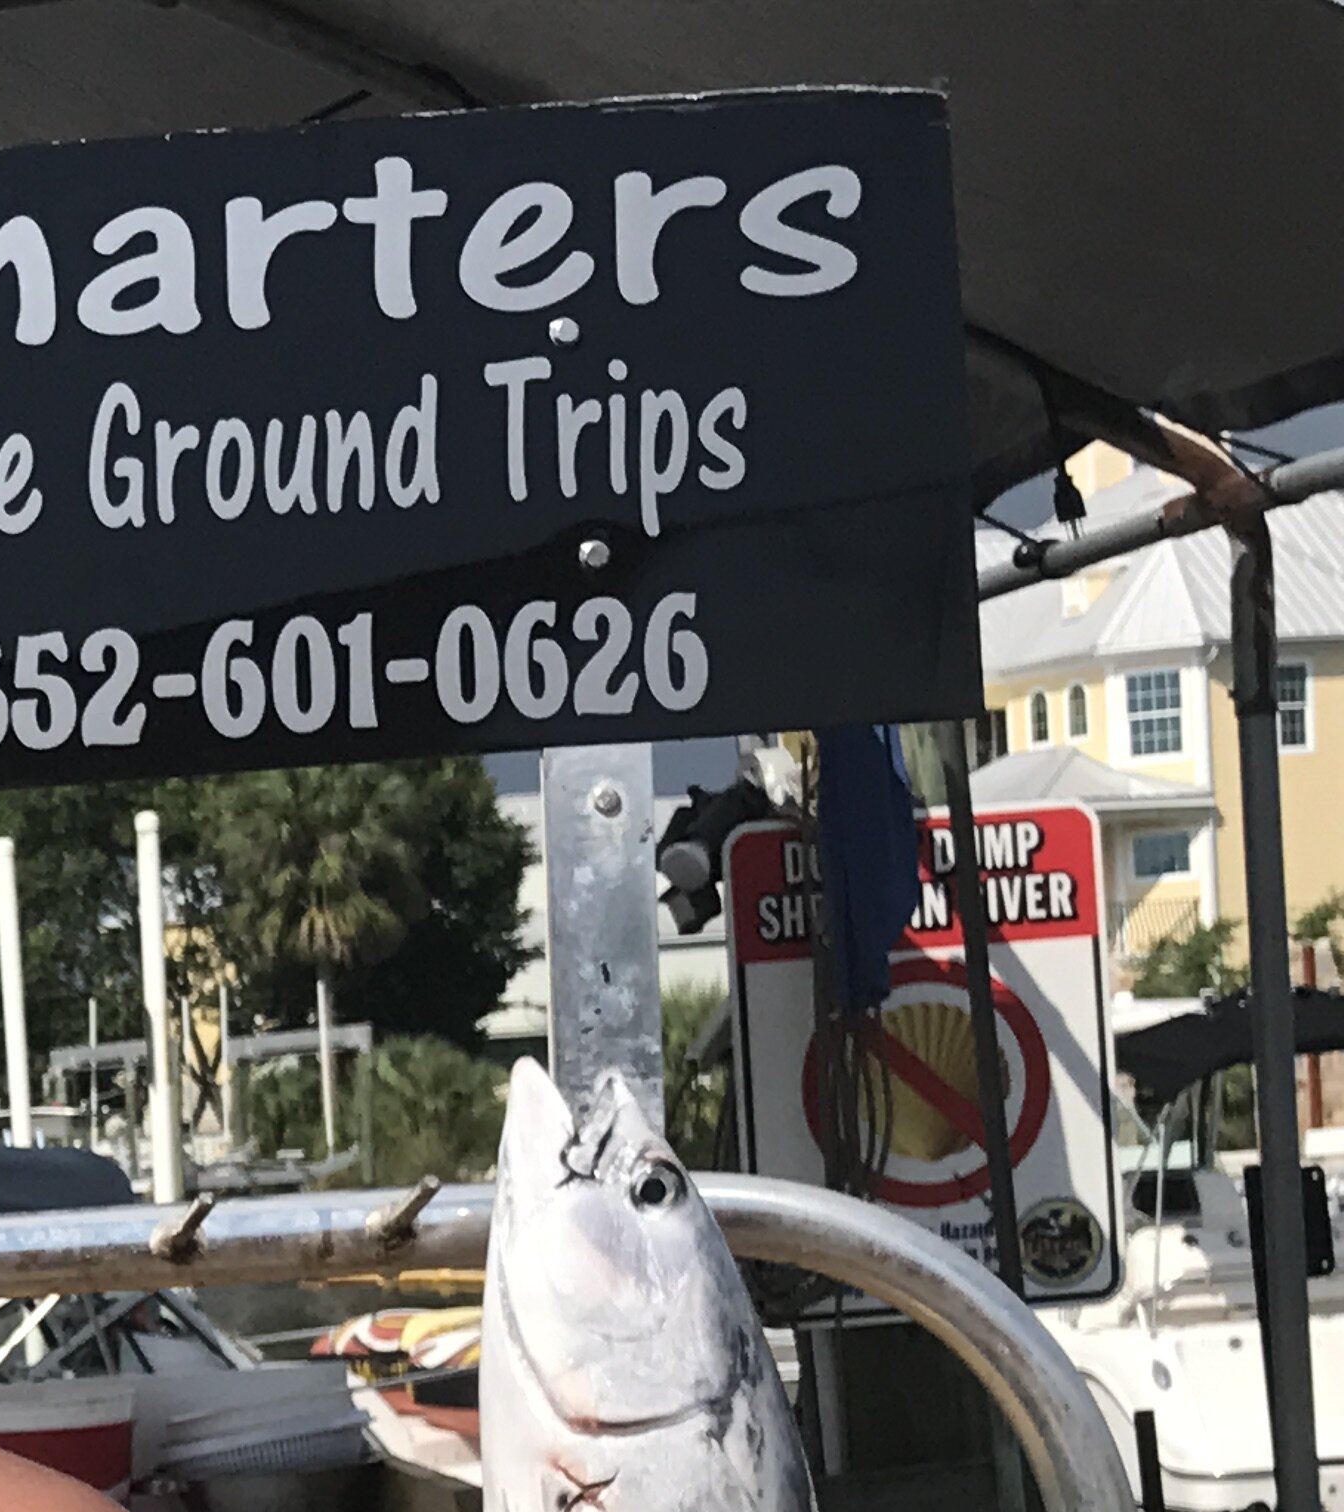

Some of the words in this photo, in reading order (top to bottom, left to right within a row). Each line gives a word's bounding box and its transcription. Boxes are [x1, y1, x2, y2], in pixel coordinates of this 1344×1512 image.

[89, 373, 440, 529] Ground
[485, 357, 747, 537] Trips
[933, 821, 1040, 873] DMP
[980, 872, 1073, 922] IVER
